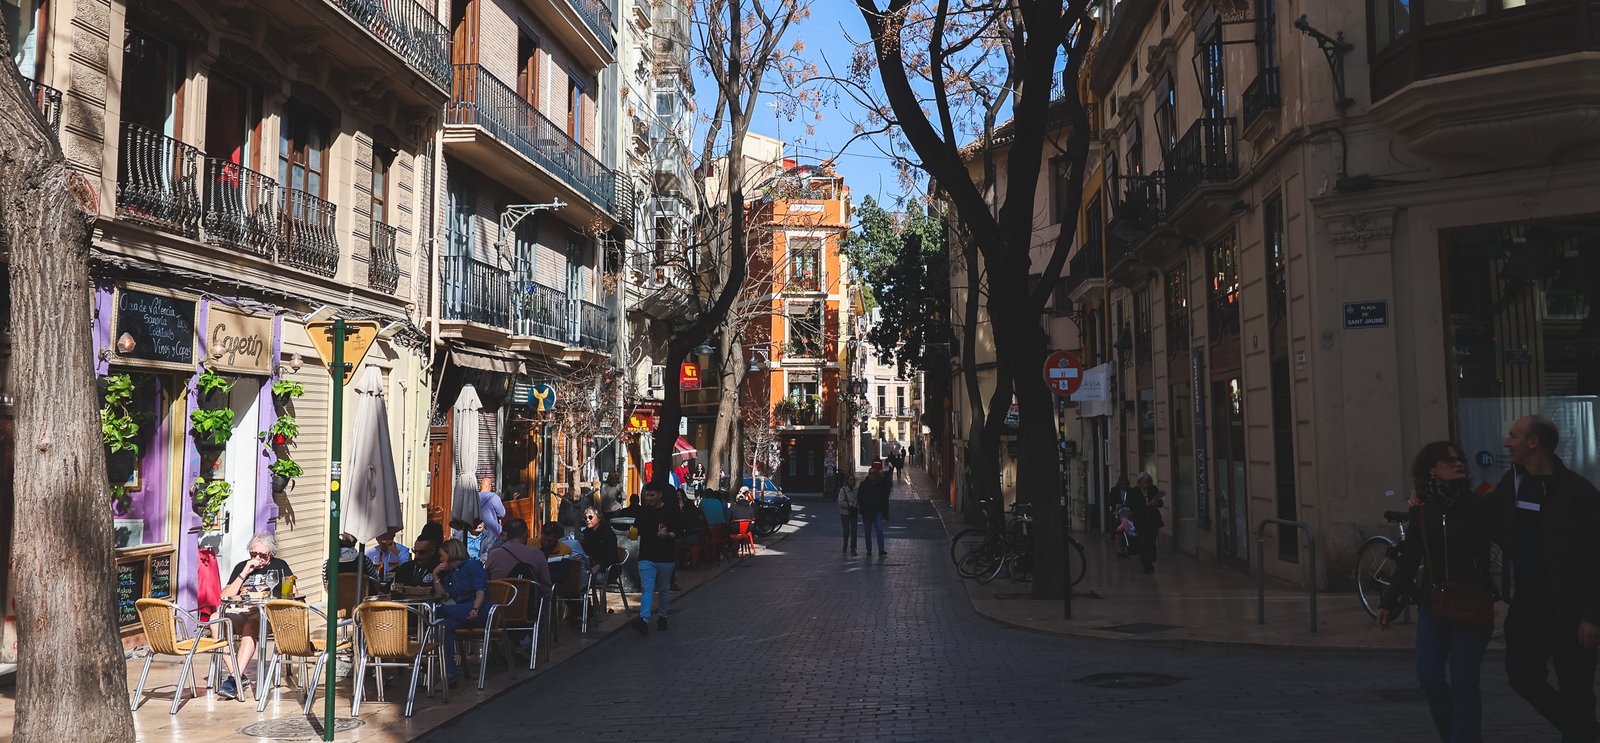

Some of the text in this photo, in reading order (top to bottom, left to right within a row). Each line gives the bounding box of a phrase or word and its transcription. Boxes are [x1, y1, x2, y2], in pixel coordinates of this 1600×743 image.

[148, 297, 175, 317] Valencia
[152, 337, 170, 358] Vinos
[175, 340, 192, 361] Copas
